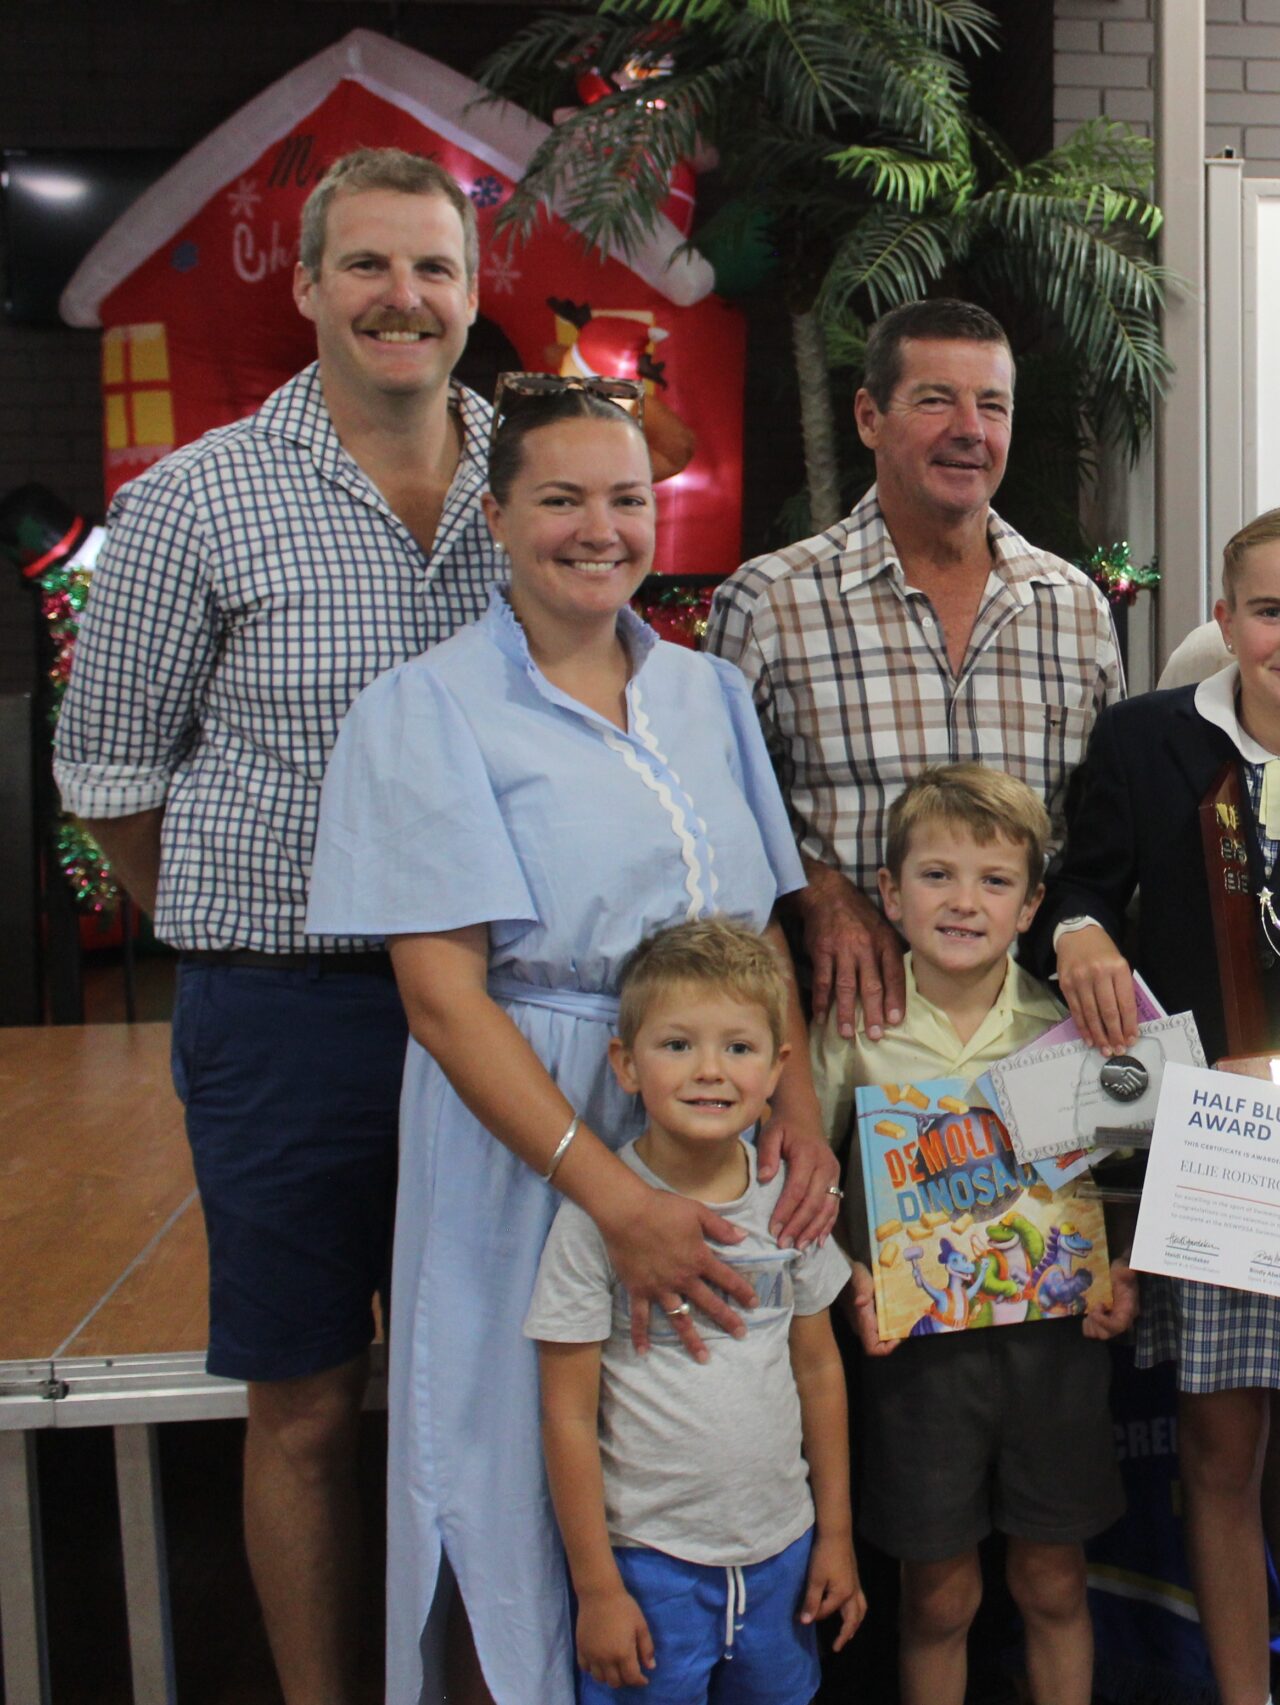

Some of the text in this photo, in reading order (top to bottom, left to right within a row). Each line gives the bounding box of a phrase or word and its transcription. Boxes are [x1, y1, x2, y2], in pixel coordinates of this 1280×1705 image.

[1192, 1089, 1247, 1113] HALF
[1188, 1111, 1272, 1141] AWARD
[1183, 1139, 1199, 1149] THIS
[1200, 1142, 1242, 1157] CERTIFICATE
[1242, 1150, 1250, 1158] IS
[1180, 1159, 1219, 1178] ELLIE
[1112, 1416, 1177, 1461] CRE
